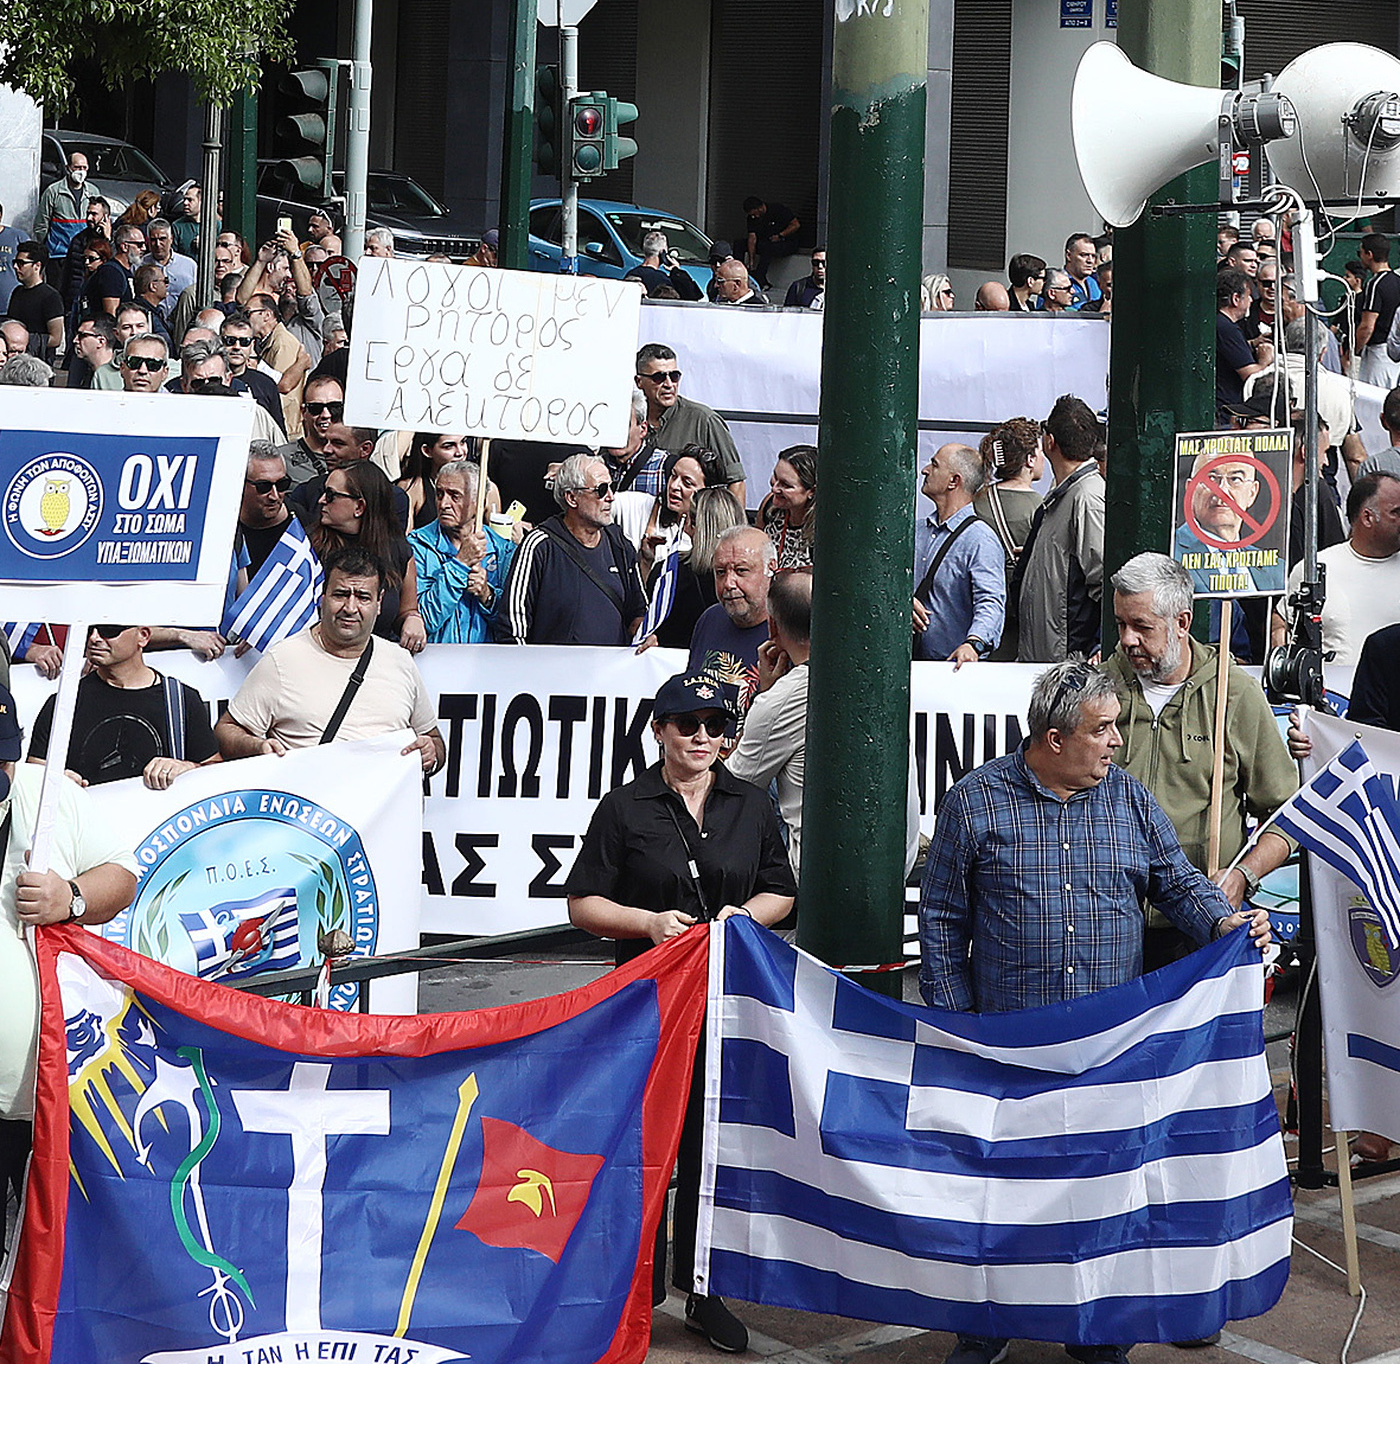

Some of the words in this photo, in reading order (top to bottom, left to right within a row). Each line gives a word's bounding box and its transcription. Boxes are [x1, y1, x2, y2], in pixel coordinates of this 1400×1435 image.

[1179, 439, 1201, 456] ΜΑΣ
[1254, 435, 1289, 452] ΠΟΛΛΑ
[8, 477, 29, 511] ΦΩΝΗ
[27, 460, 50, 479] ΤΩΝ
[117, 453, 198, 511] ΟΧΙ
[112, 513, 143, 534] ΣΤΟ
[144, 513, 186, 534] ΣΩΜΑ
[96, 540, 193, 564] ΥΠΑΞΙΩΜΑΤΙΚΩΝ
[423, 692, 656, 799] ΤΙΩΤΙΚ
[258, 794, 353, 848] ΕΝΩΣΕΩΝ
[242, 1345, 283, 1364] ΤΑΝ
[295, 1342, 310, 1360] Η
[318, 1341, 358, 1361] ΕΠΙ
[374, 1344, 420, 1364] ΤΑΣ
